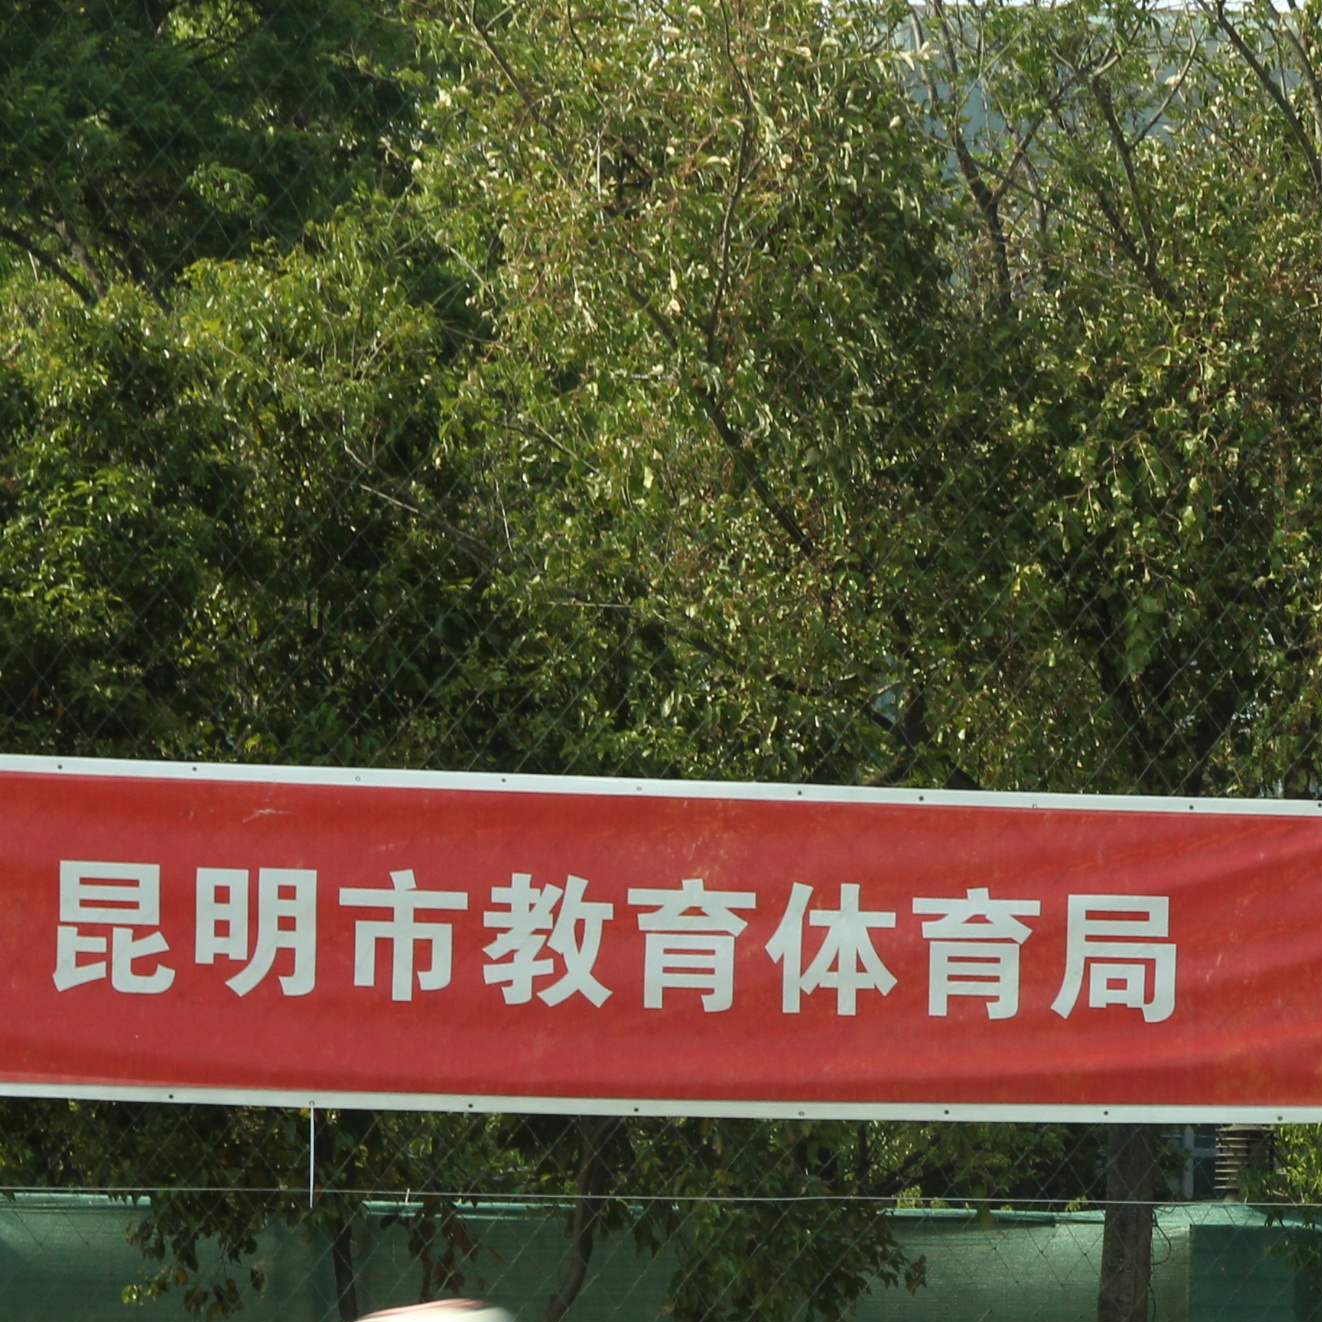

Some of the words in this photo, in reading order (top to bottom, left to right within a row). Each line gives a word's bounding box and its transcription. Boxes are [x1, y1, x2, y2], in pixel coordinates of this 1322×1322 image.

[53, 859, 1178, 1023] 昆明市教育体育局
